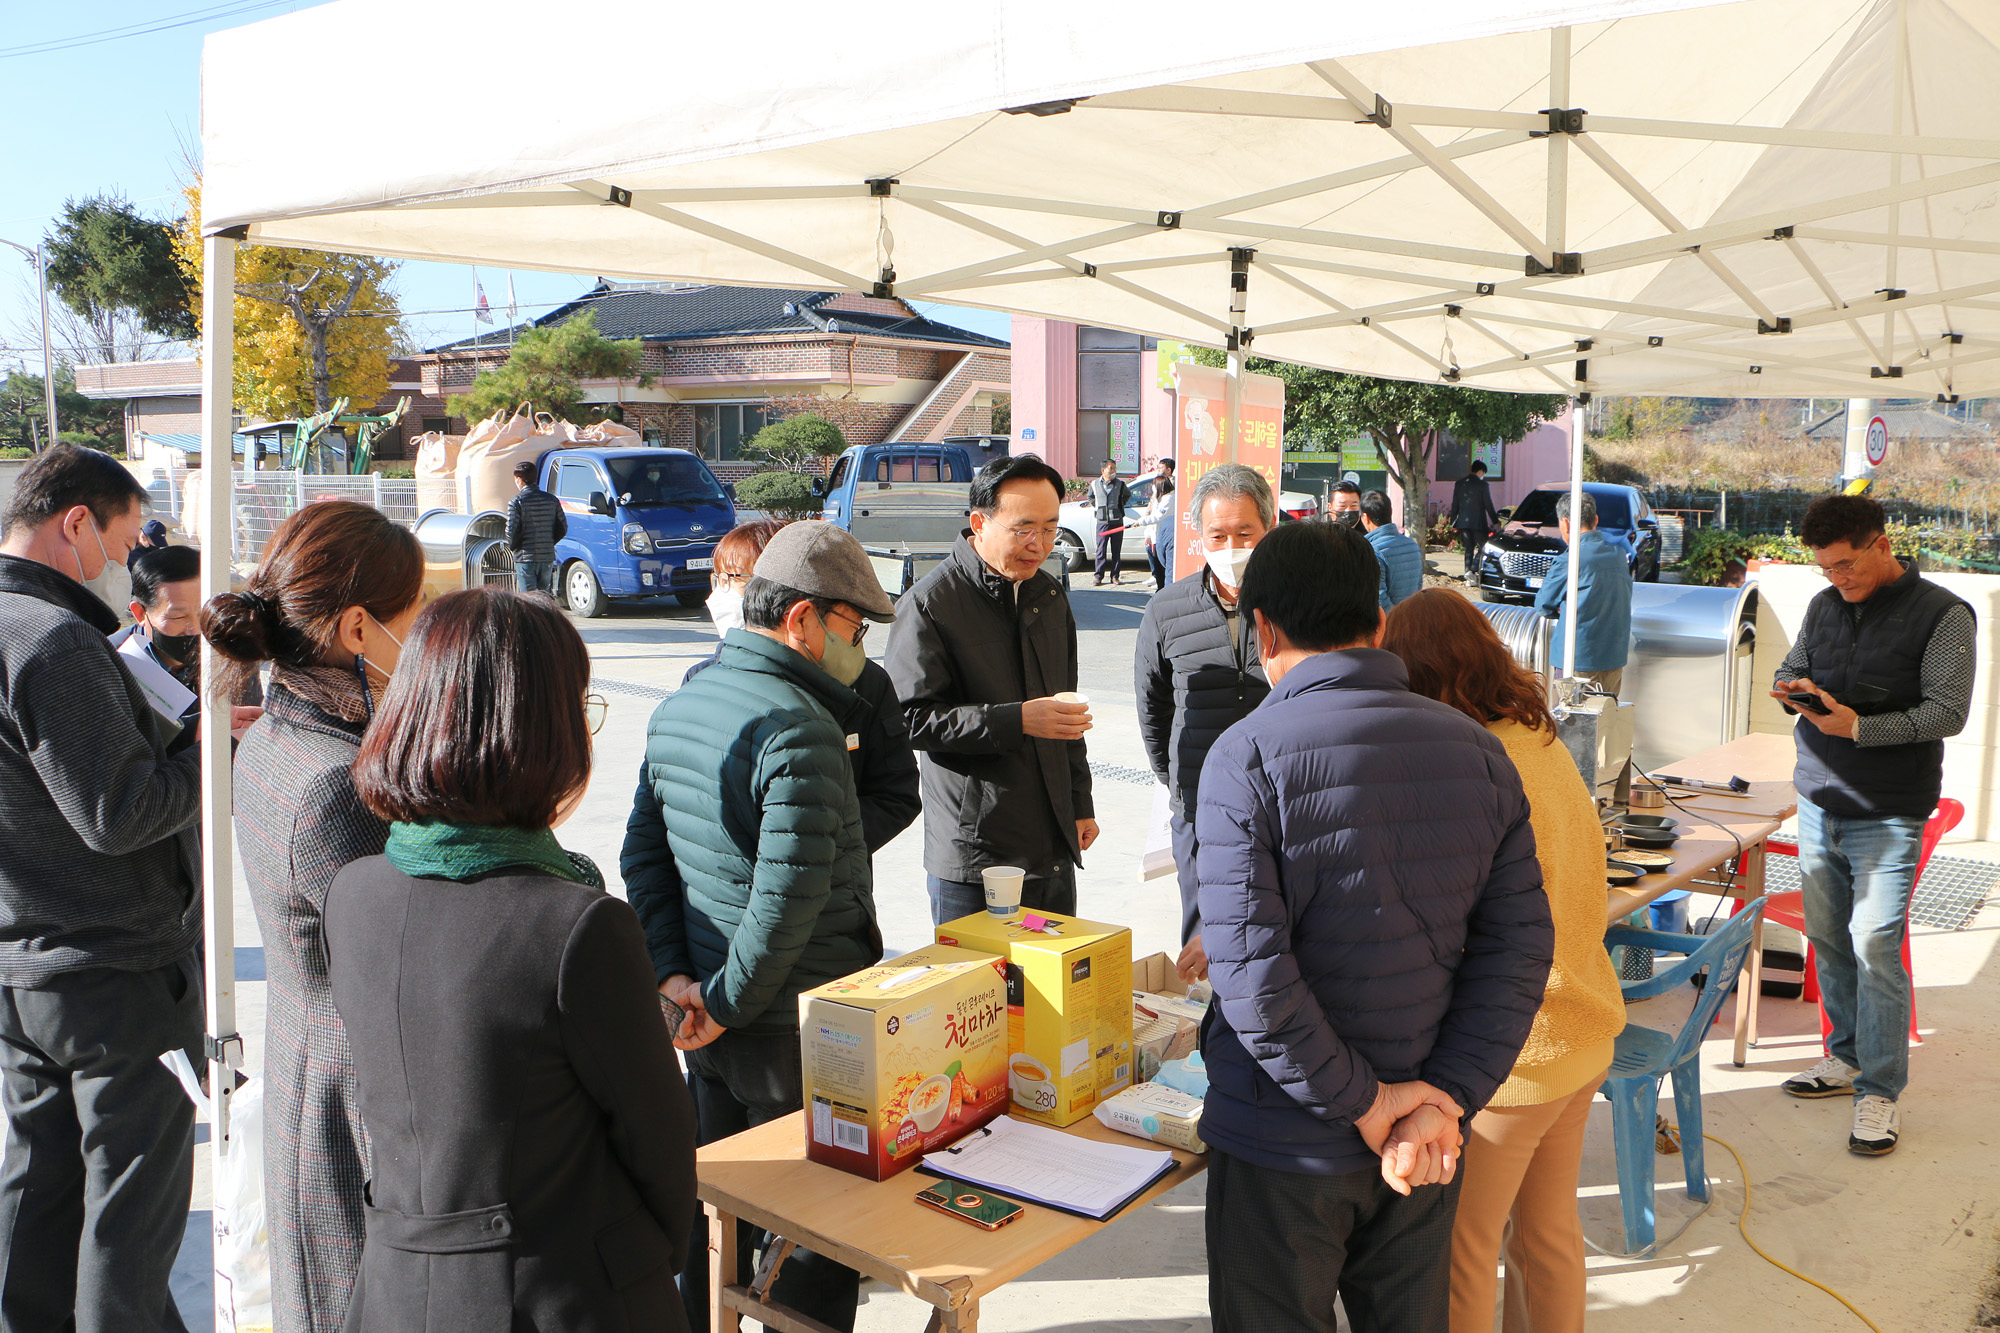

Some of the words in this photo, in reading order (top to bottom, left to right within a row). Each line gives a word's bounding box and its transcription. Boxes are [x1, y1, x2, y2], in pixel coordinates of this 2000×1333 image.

[1127, 420, 1136, 463] 방문목욕
[1870, 429, 1884, 451] 30
[944, 1001, 1004, 1049] 천마차
[1035, 1090, 1057, 1109] 280
